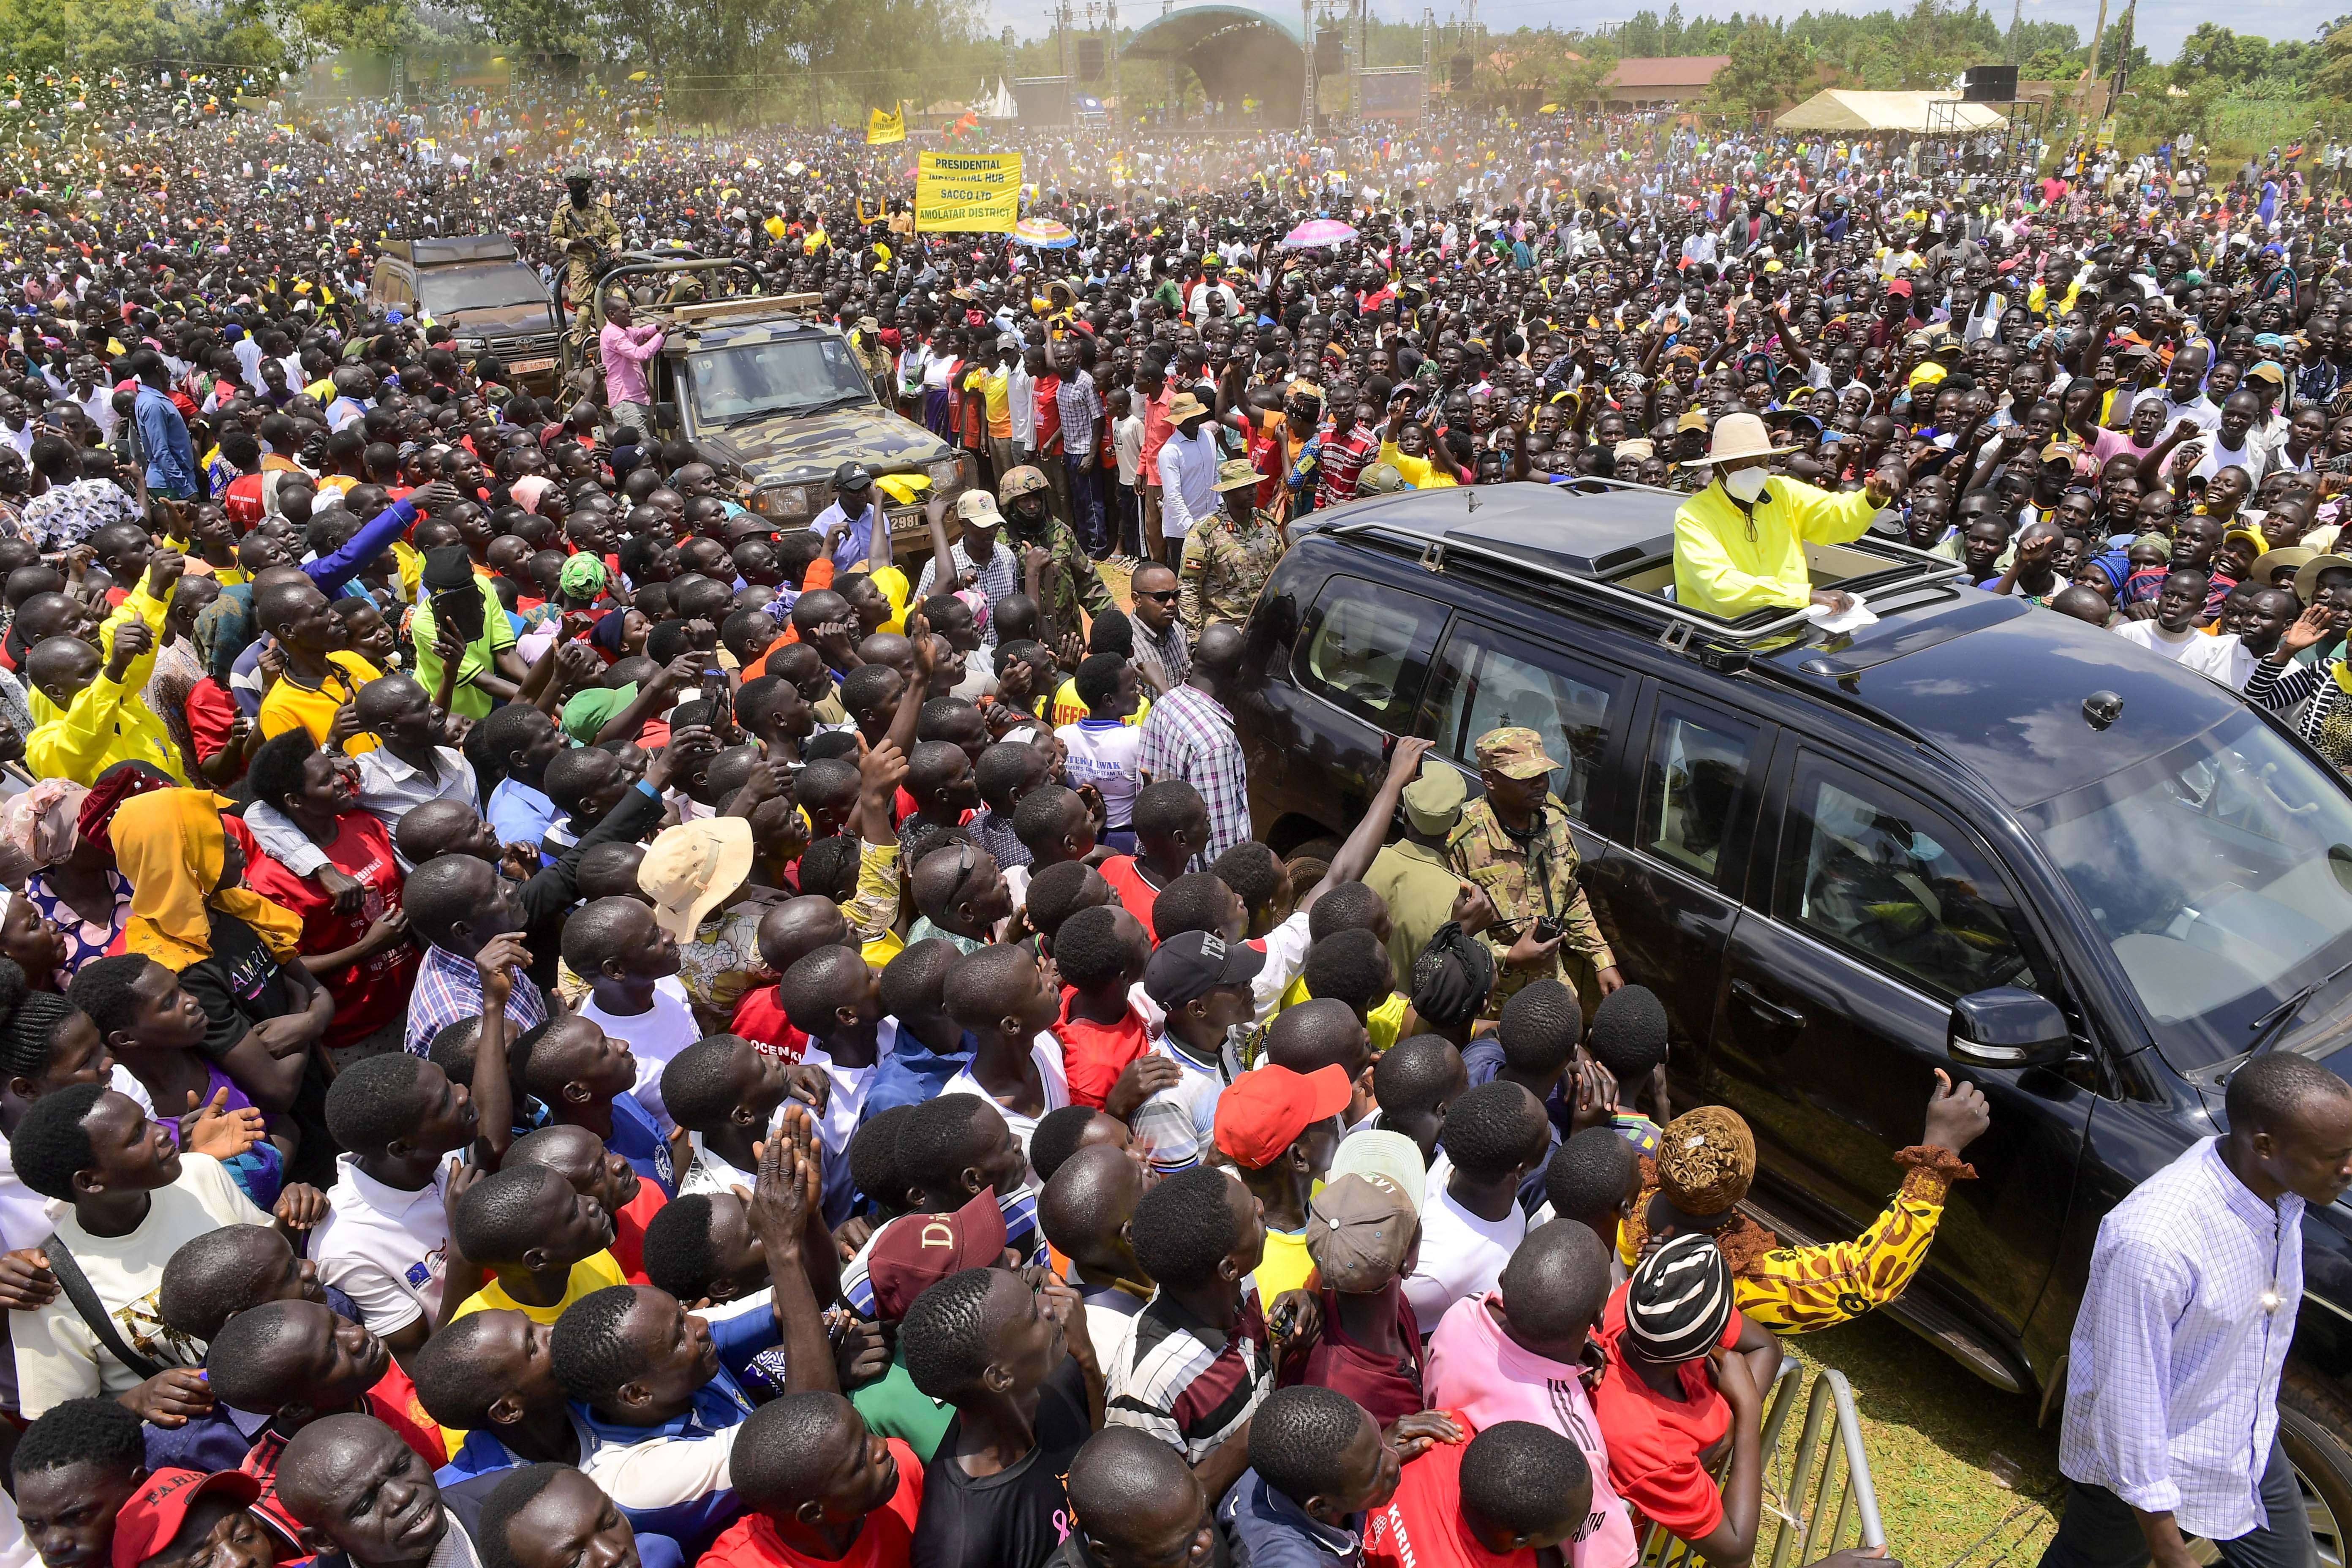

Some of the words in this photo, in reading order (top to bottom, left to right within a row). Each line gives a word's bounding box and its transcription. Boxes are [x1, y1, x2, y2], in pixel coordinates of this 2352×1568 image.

[936, 158, 1001, 170] PRESIDENTIAL
[985, 173, 1004, 183] HUB
[941, 189, 973, 200] SACCO
[976, 191, 991, 201] LTD
[920, 208, 965, 220] AMOLATAR
[969, 207, 1010, 218] DISTRICT
[1941, 332, 1960, 346] KING
[890, 514, 919, 531] 2981
[354, 857, 384, 882] EOFFREY
[350, 919, 364, 928] UPC
[750, 1040, 789, 1056] OCEN
